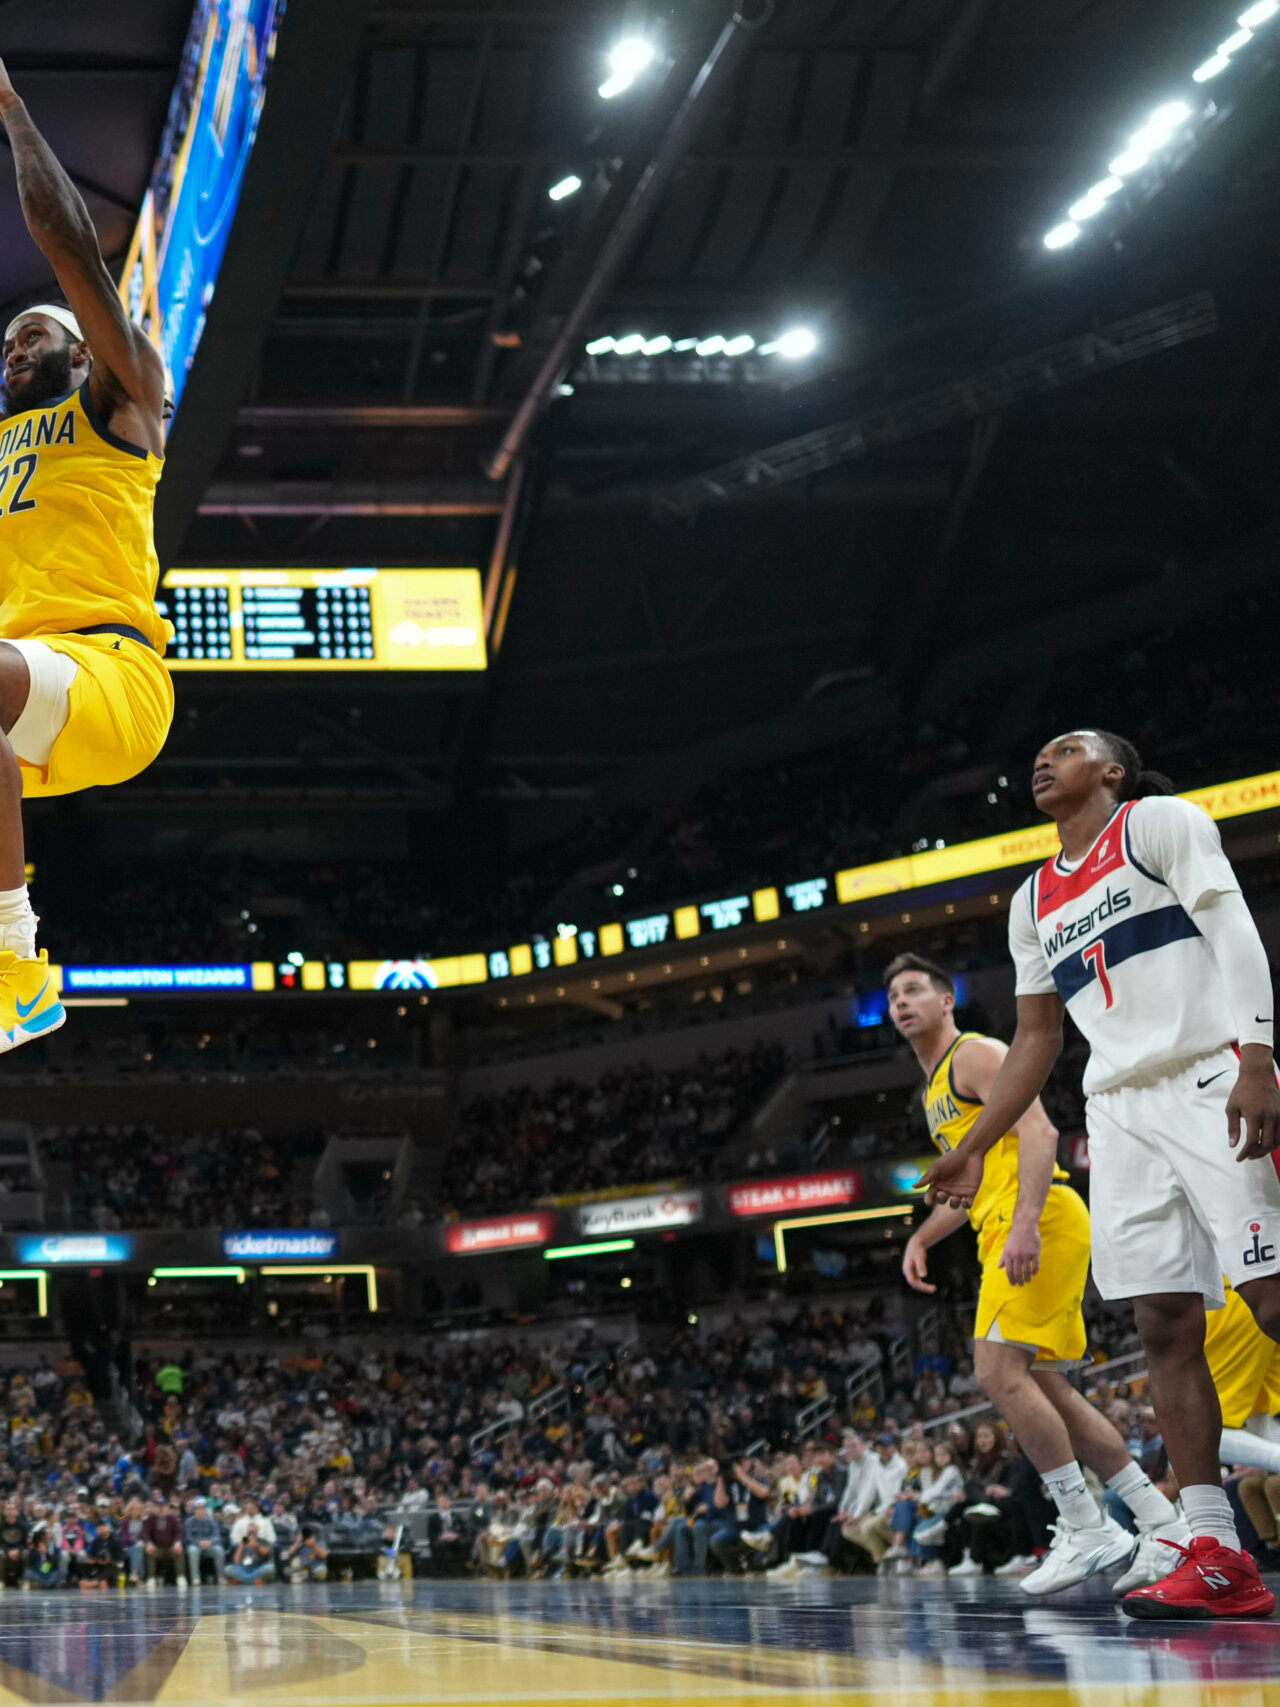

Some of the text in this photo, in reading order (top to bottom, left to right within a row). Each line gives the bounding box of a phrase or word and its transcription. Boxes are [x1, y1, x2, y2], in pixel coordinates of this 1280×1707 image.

[69, 968, 246, 987] WASHINGTON WIZARDS
[1081, 938, 1114, 1011] 7
[731, 1187, 784, 1210] STEAK
[798, 1177, 857, 1200] SHAKE
[581, 1207, 656, 1232] KeyBank
[224, 1234, 336, 1255] ticketmaster
